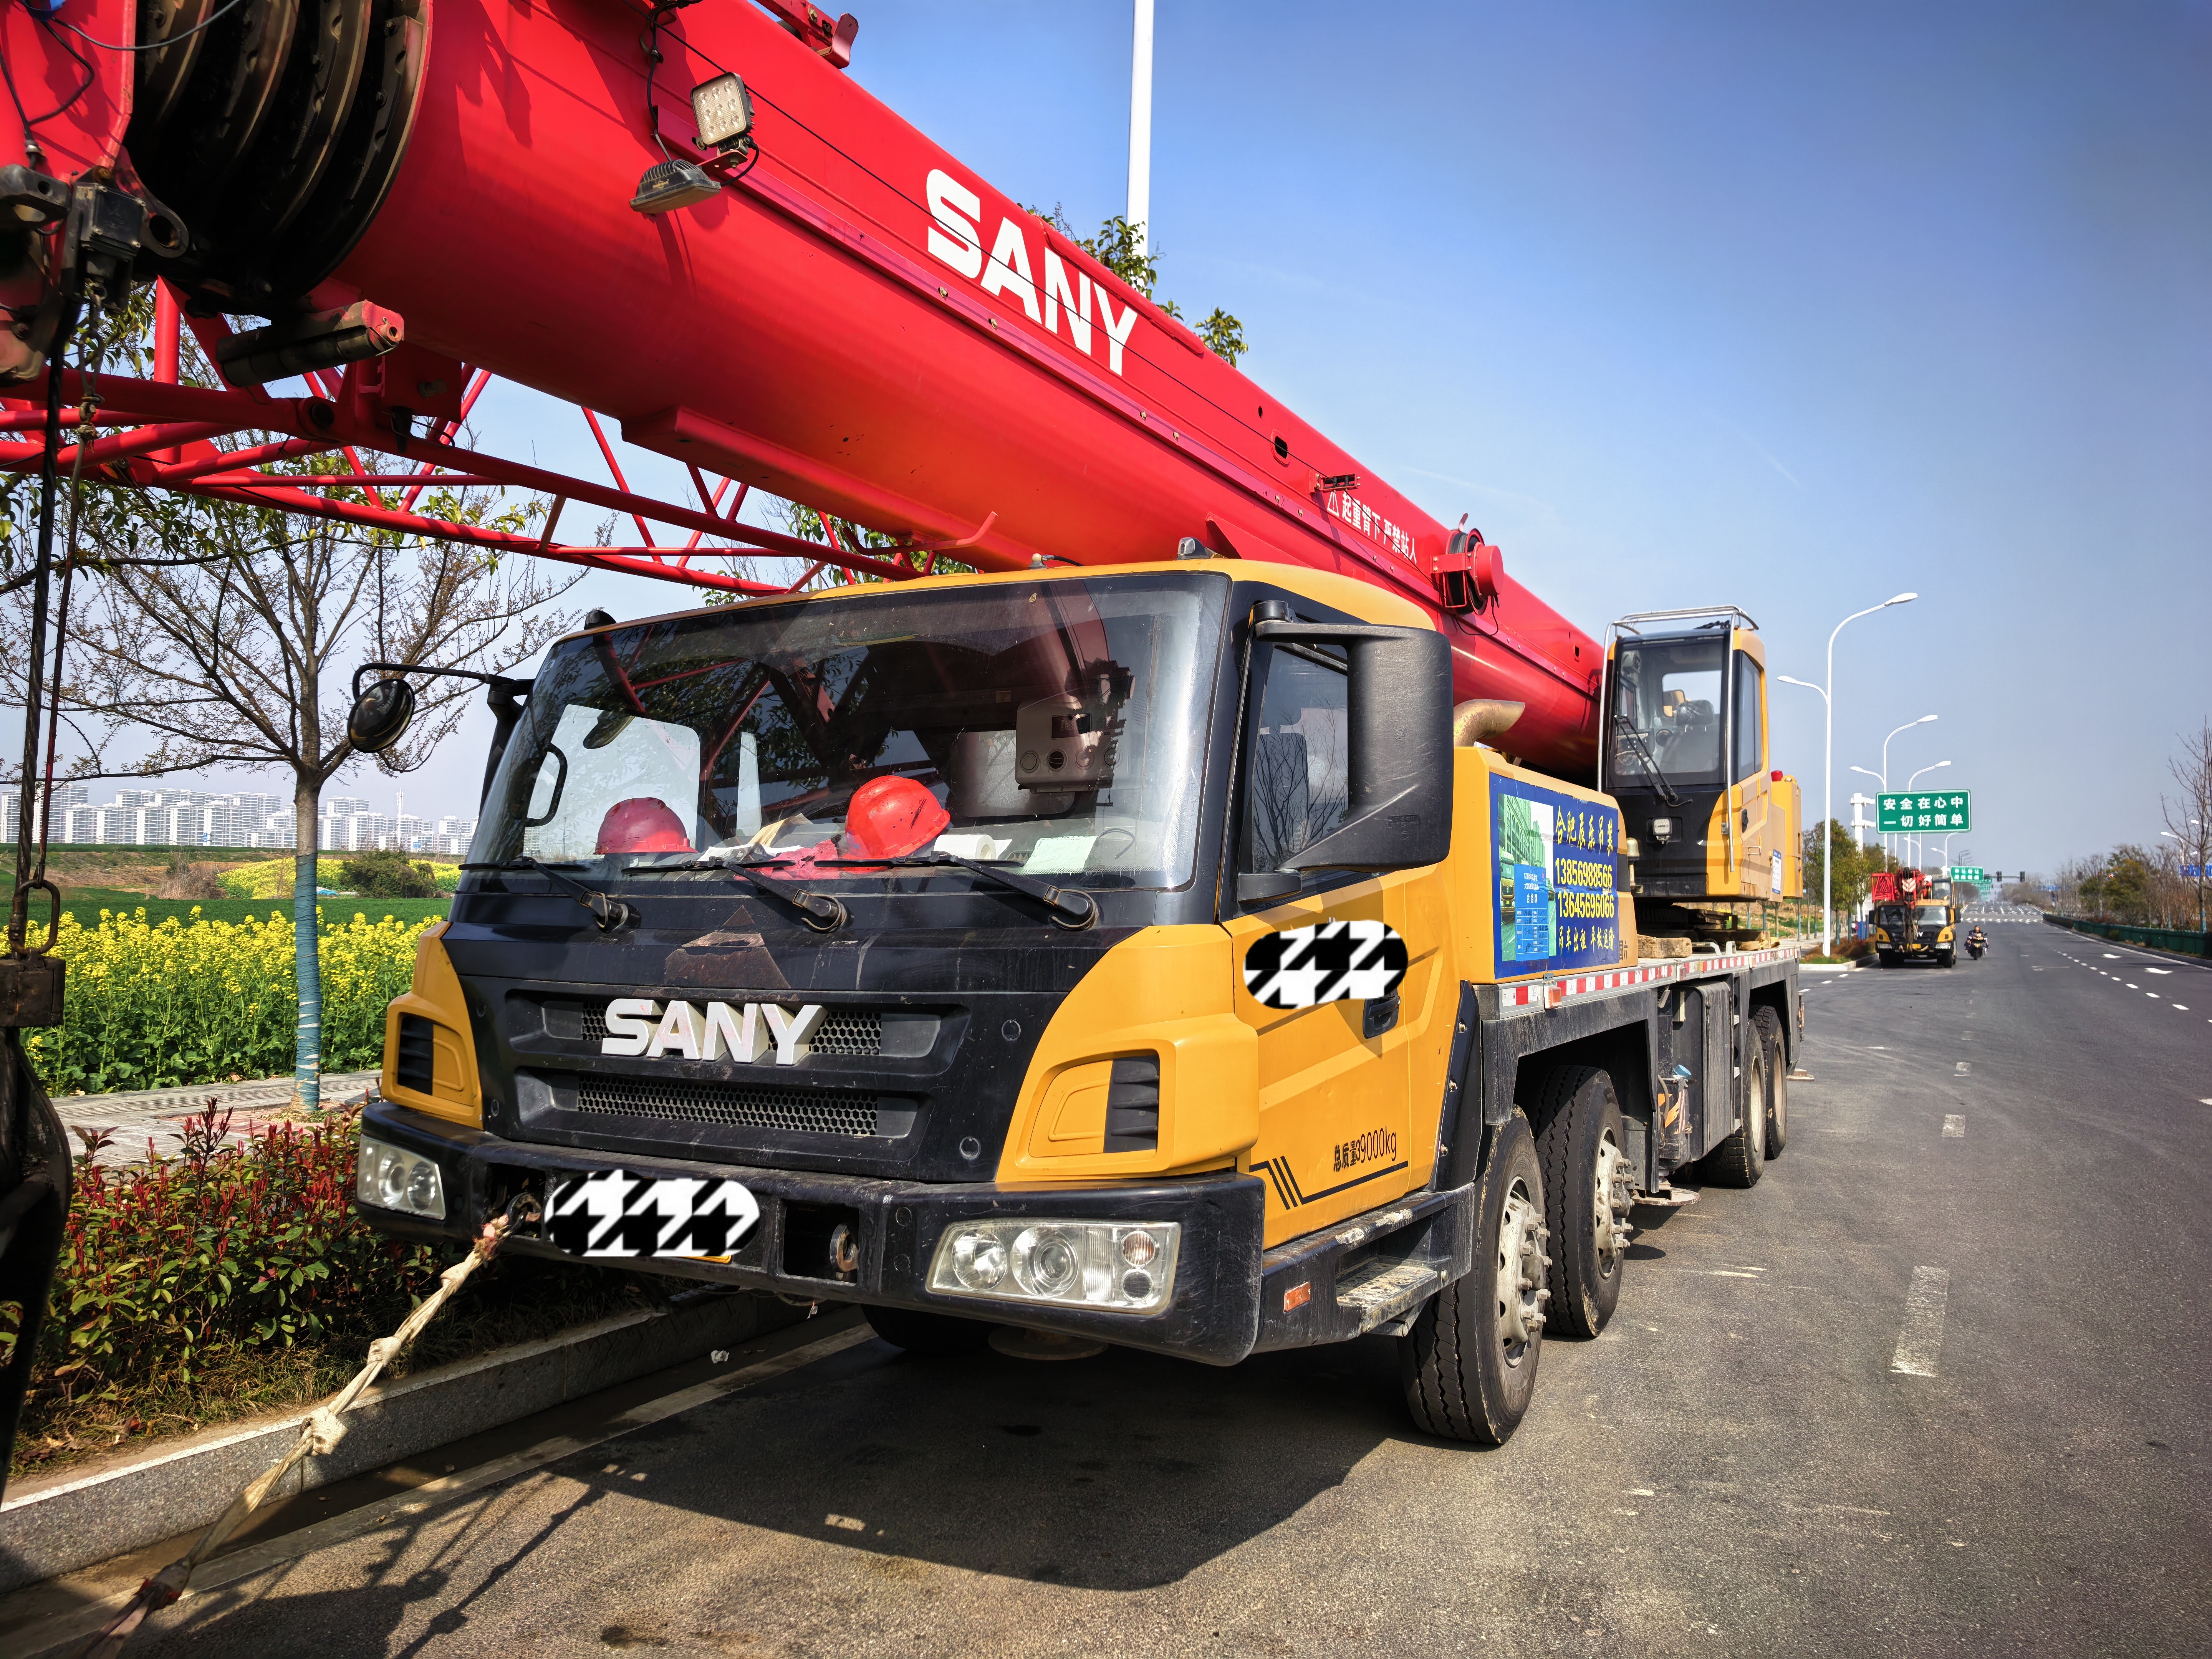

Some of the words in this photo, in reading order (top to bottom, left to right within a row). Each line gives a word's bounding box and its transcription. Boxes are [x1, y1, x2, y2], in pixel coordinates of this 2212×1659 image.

[926, 169, 1137, 376] SANY
[1883, 796, 1963, 810] 安全在心中
[1883, 813, 1963, 827] 一切好简单
[1555, 858, 1612, 888] 13856988566
[1558, 891, 1614, 918] 13645696066
[602, 998, 826, 1065] SANY
